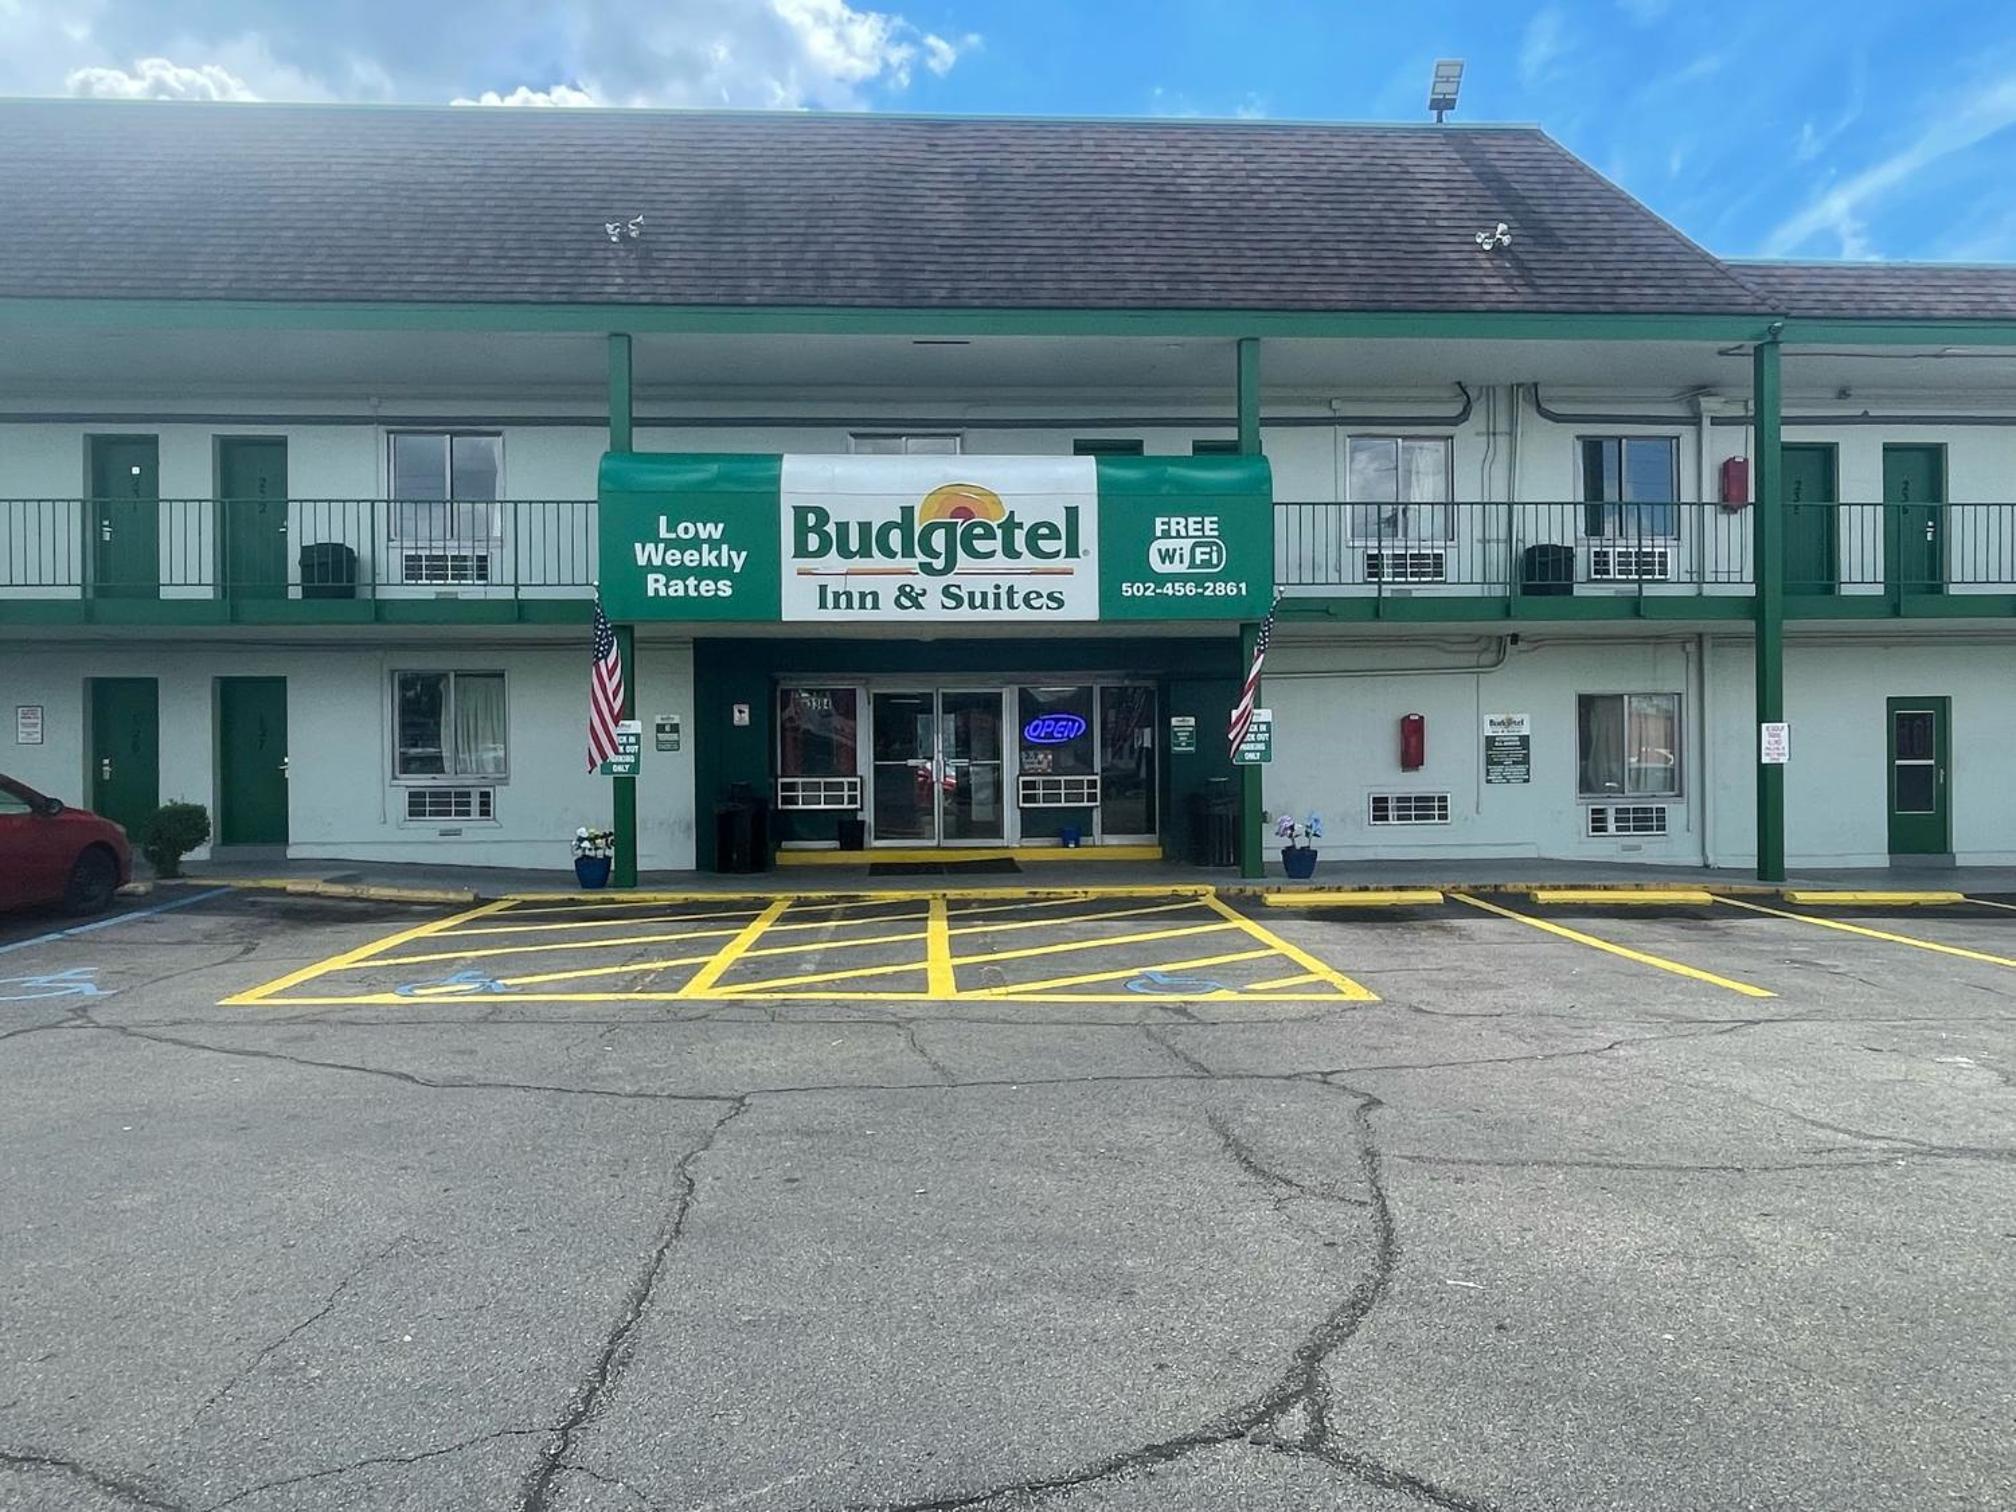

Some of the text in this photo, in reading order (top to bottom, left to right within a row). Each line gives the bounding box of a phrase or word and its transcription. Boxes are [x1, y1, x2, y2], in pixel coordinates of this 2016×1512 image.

[659, 515, 725, 540] Low
[1155, 516, 1219, 537] FREE
[792, 505, 1081, 577] Budgetel
[634, 542, 748, 573] Weekly
[647, 573, 733, 597] Rates
[1121, 581, 1247, 597] 502-456-2861
[817, 583, 1066, 610] Inn & Suites
[1029, 719, 1079, 738] OPEN
[1256, 733, 1270, 741] OUT
[1244, 752, 1260, 760] ONLY
[612, 764, 630, 772] ONLY
